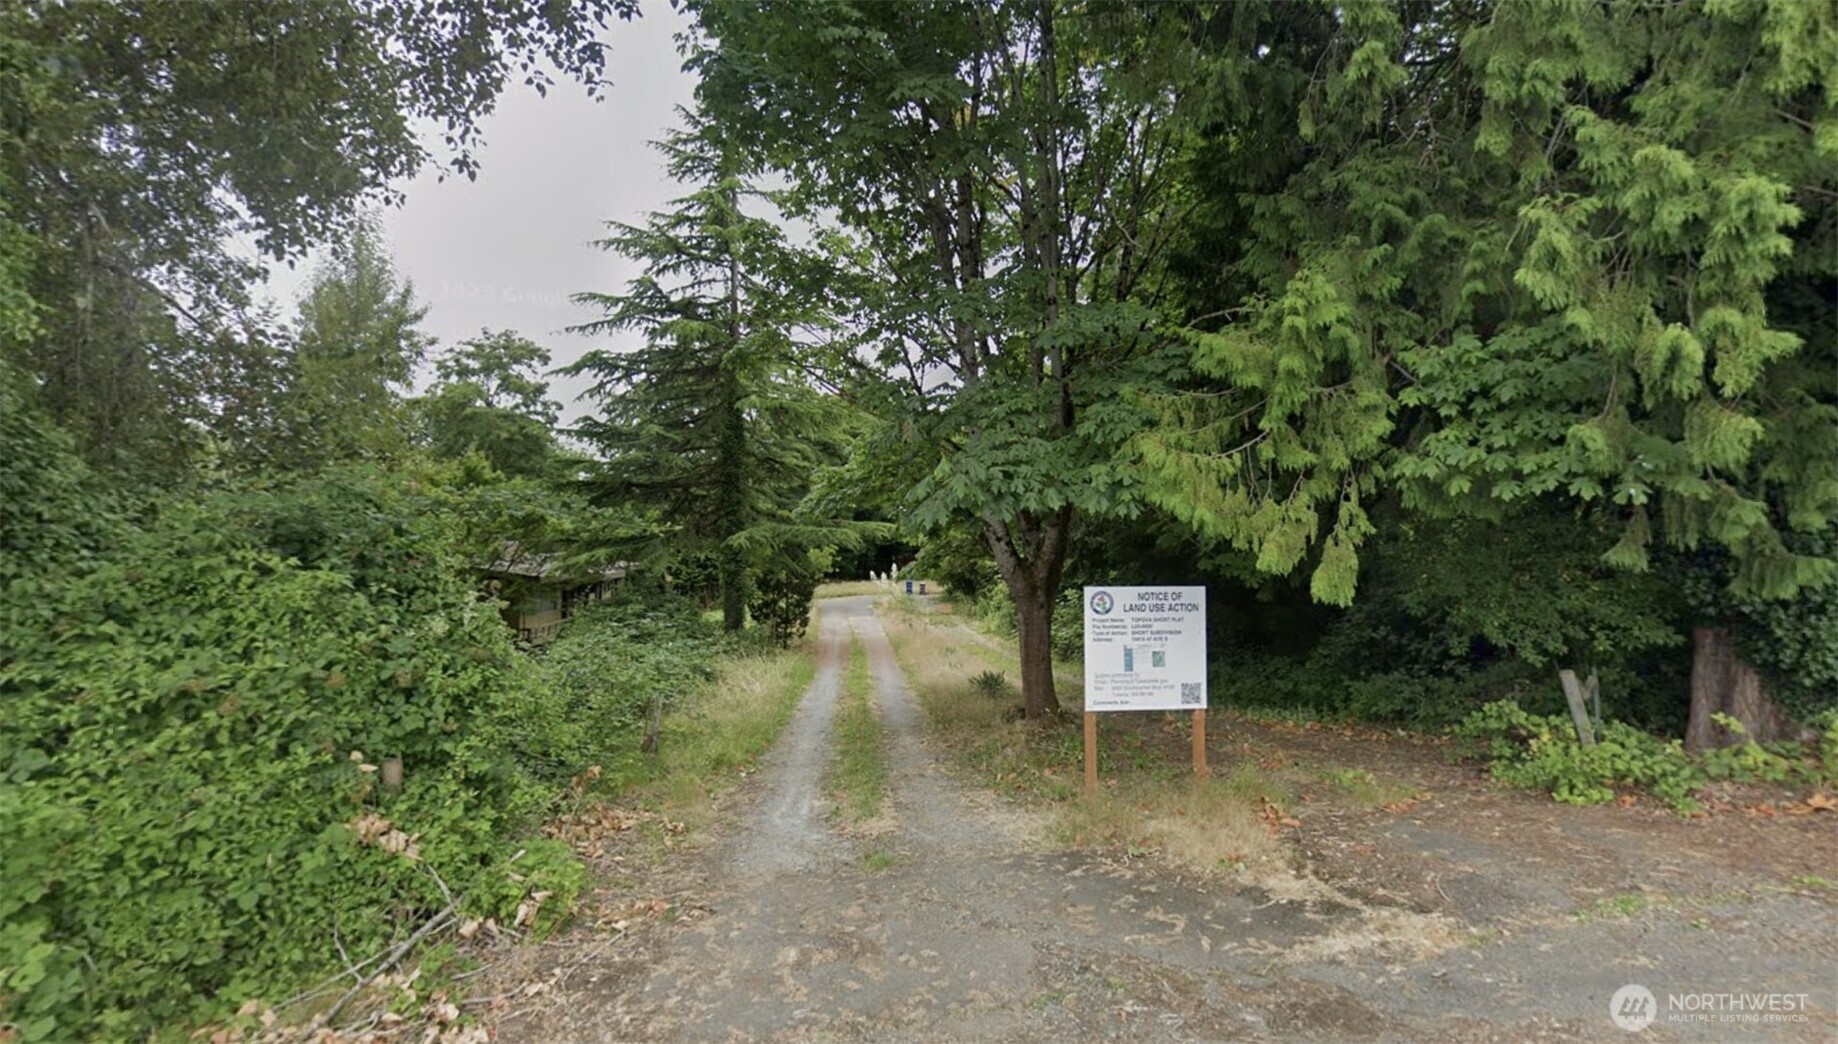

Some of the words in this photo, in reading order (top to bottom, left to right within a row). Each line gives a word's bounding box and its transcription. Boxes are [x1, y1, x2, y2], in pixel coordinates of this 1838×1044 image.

[1137, 592, 1169, 602] NOTICE
[1171, 592, 1183, 602] OF
[1123, 603, 1147, 613] LAND
[1149, 603, 1166, 613] USE
[1167, 602, 1199, 612] ACTION
